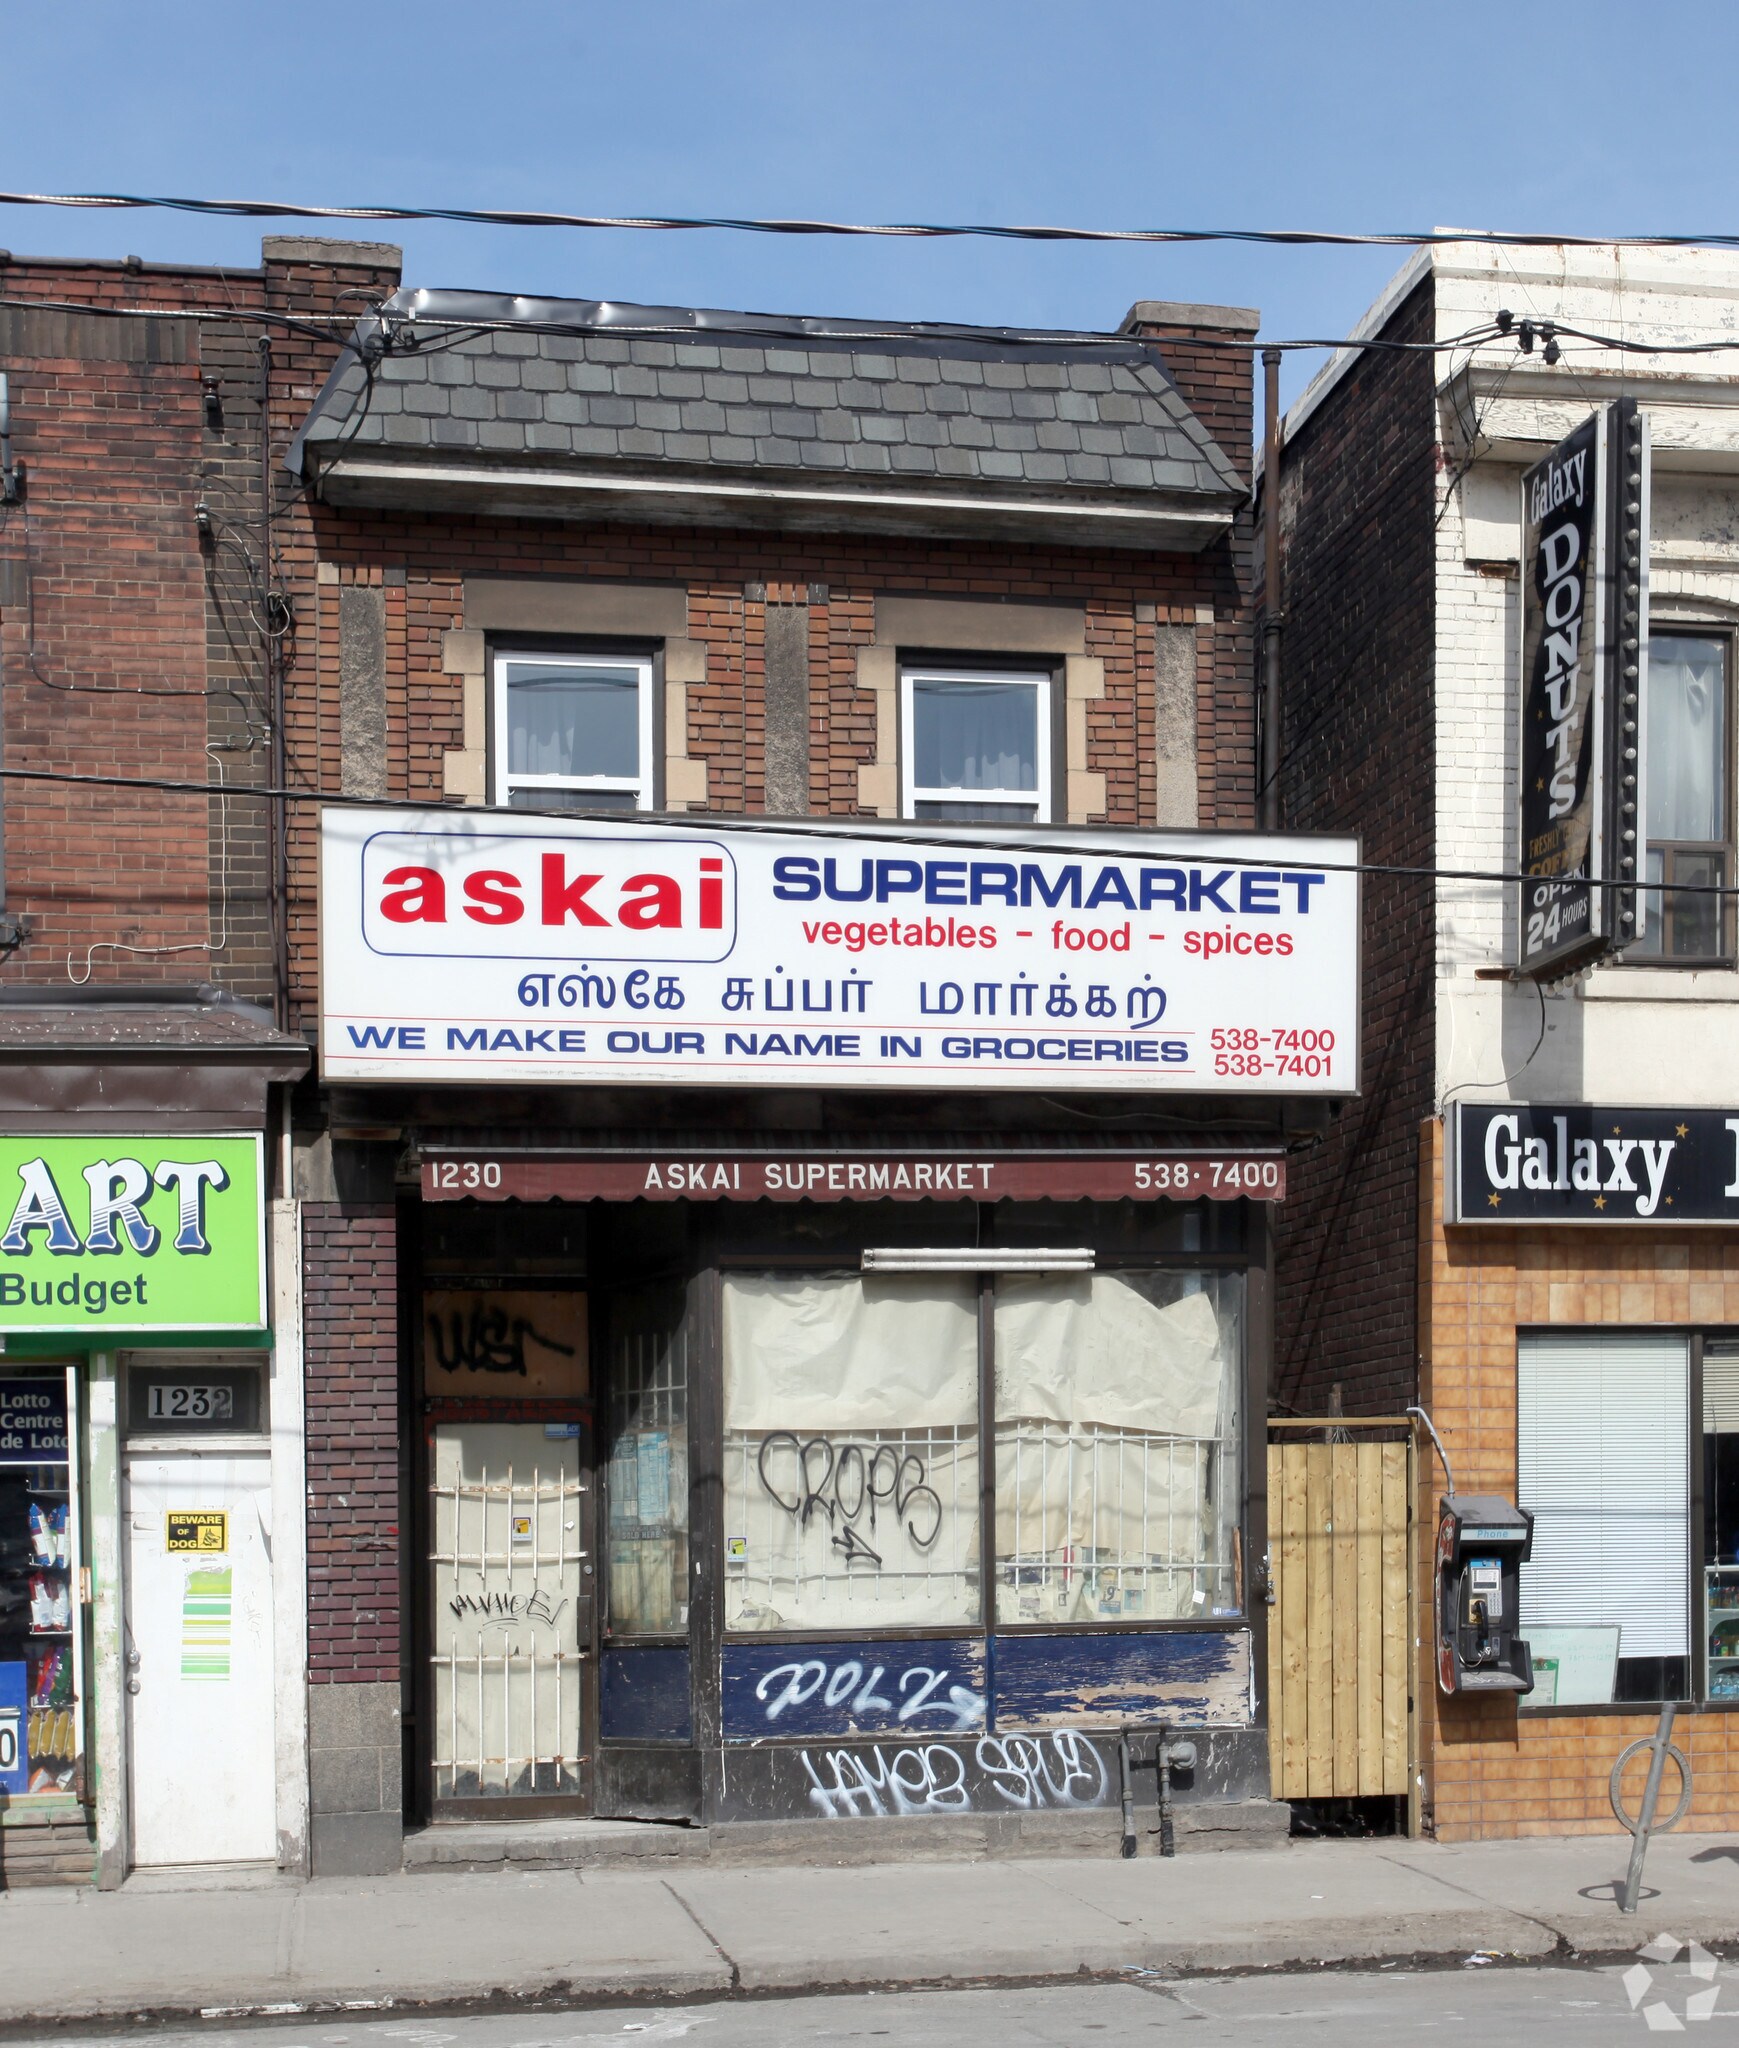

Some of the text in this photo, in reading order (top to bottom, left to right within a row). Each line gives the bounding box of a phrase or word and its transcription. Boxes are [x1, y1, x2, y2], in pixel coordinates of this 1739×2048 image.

[1531, 448, 1587, 526] Galaxy
[1540, 522, 1582, 821] DONUTS
[380, 853, 723, 930] askai
[773, 856, 1326, 914] SUPERMARKET
[802, 917, 997, 952] vegetables
[1051, 920, 1130, 951] food
[1183, 924, 1294, 960] spices
[1527, 899, 1587, 955] 24 HOURS
[347, 1026, 1188, 1062] WE MAKE OUR NAME IN GROCERIES
[1210, 1028, 1335, 1051] 538-7400
[1214, 1054, 1331, 1077] 538-7401
[432, 1162, 502, 1188] 1230
[644, 1163, 740, 1190] ASKAI
[764, 1163, 995, 1190] SUPERMARKET
[1484, 1113, 1675, 1216] Galaxy
[0, 1272, 148, 1314] Budget
[1, 1393, 50, 1408] Lotto
[153, 1386, 233, 1417] 1232
[1, 1413, 63, 1429] Centre
[1, 1433, 23, 1449] de
[171, 1515, 222, 1524] BEWARE
[1477, 1529, 1509, 1538] Phone
[169, 1539, 197, 1548] DOG
